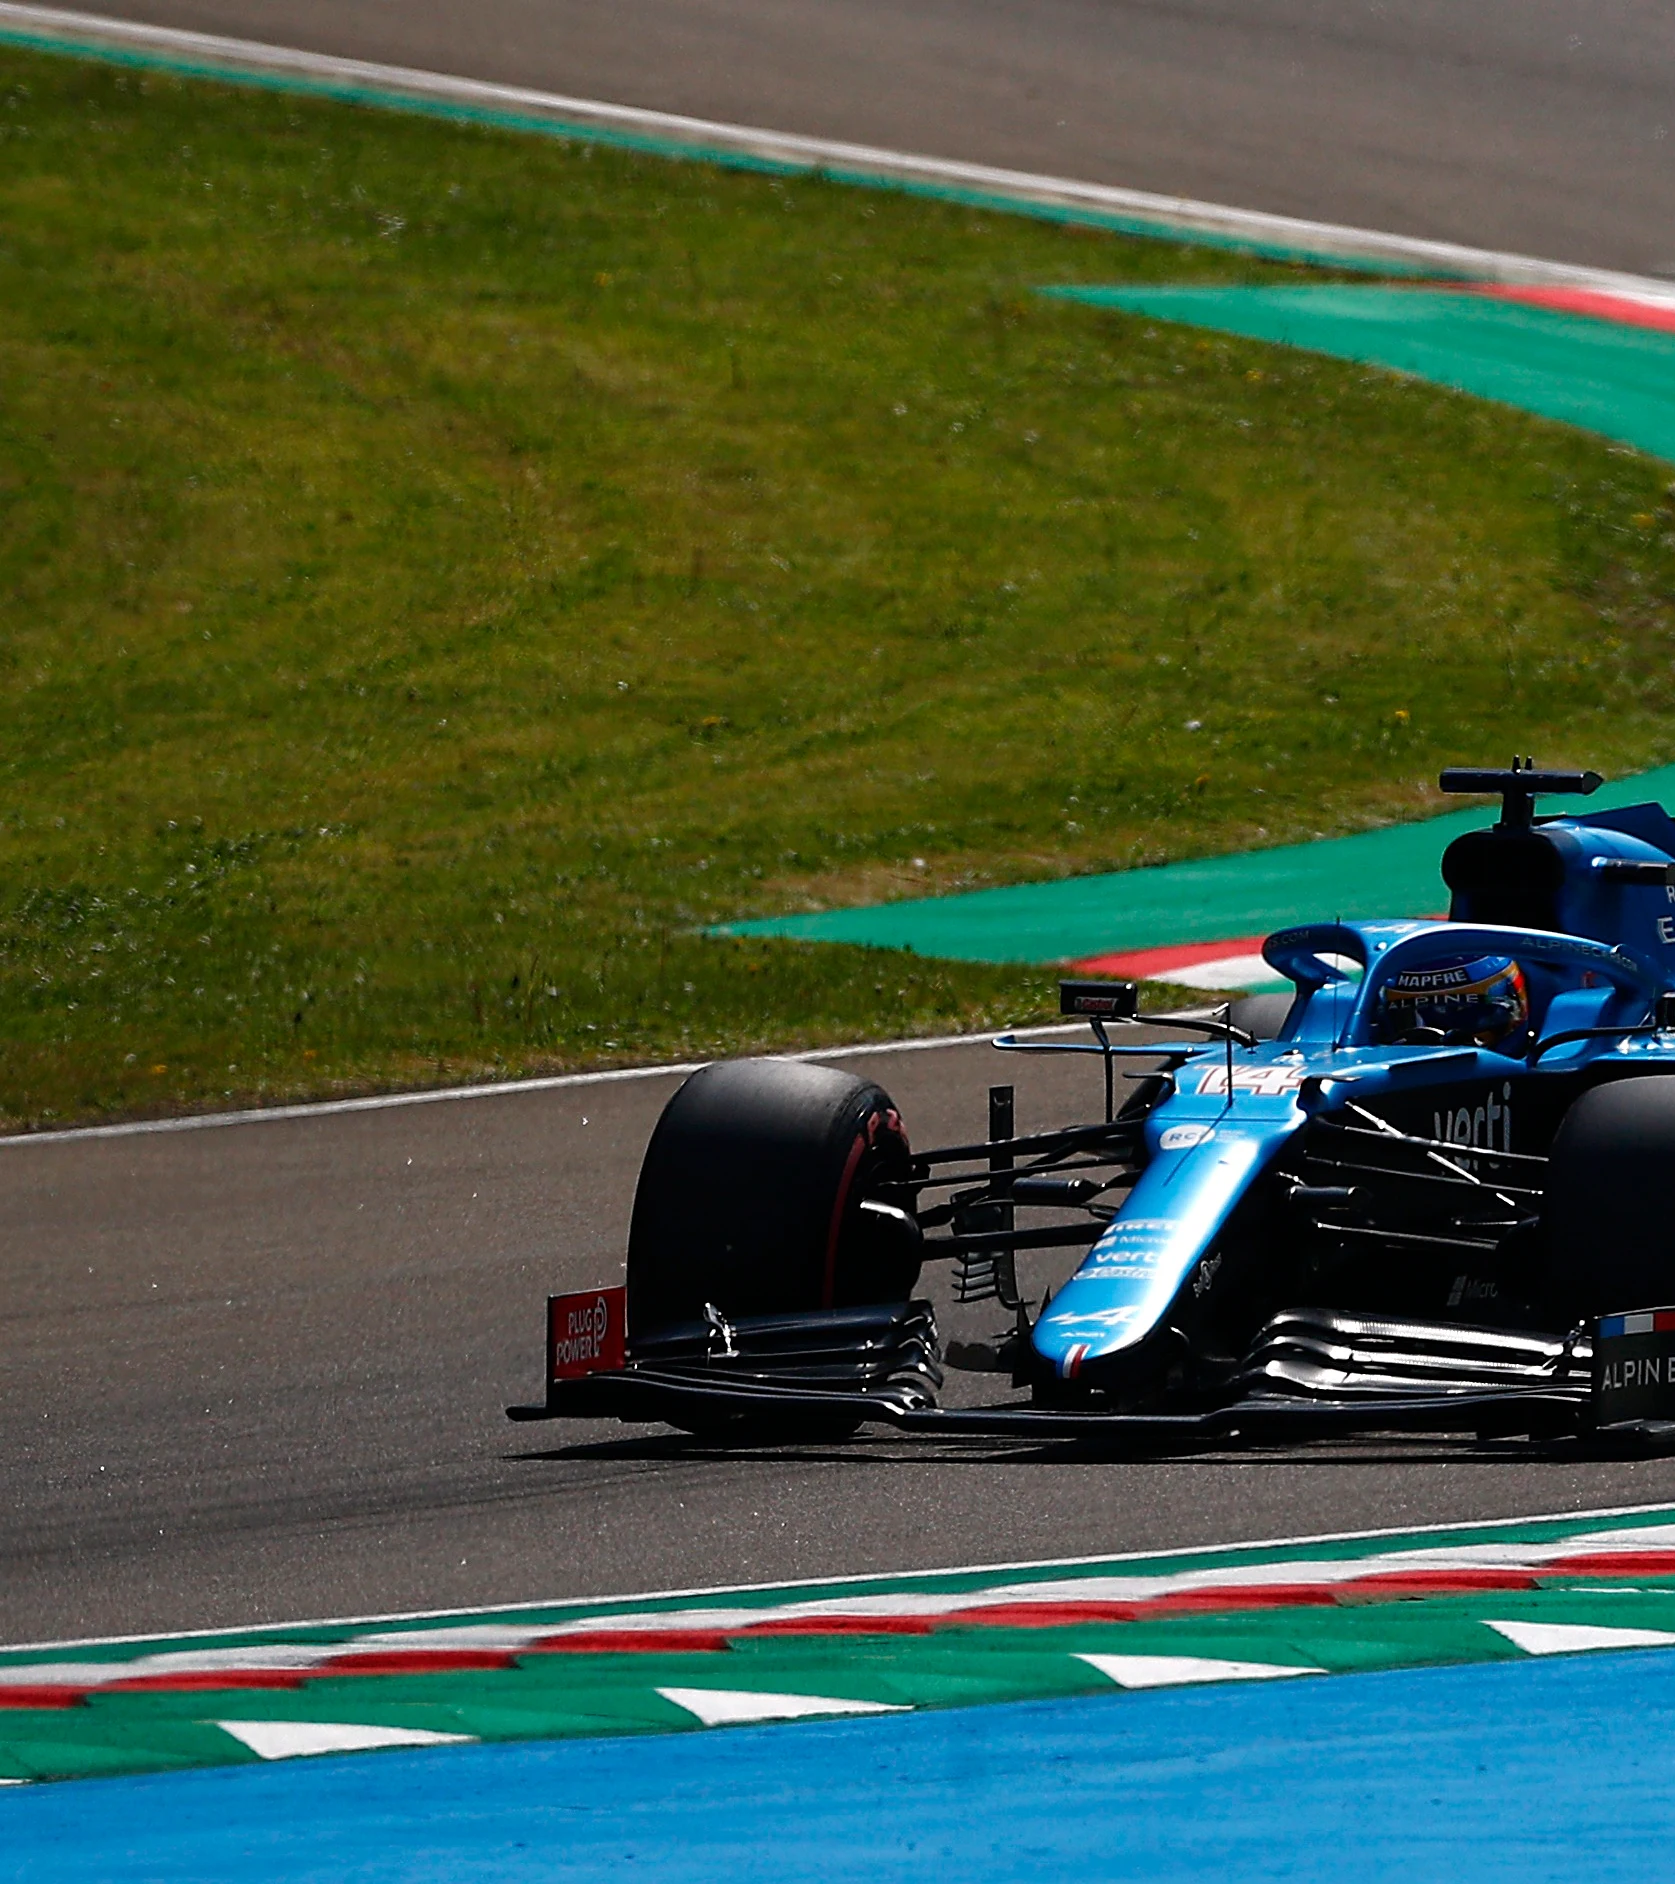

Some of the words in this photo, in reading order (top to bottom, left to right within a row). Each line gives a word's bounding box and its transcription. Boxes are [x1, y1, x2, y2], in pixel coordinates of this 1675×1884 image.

[1398, 970, 1468, 988] MAPFRE
[1388, 994, 1479, 1010] ALPINE
[1195, 1065, 1308, 1096] 14
[1434, 1081, 1512, 1171] verti
[1095, 1251, 1160, 1264] vert
[568, 1308, 592, 1336] PLUG
[556, 1335, 593, 1367] POWER
